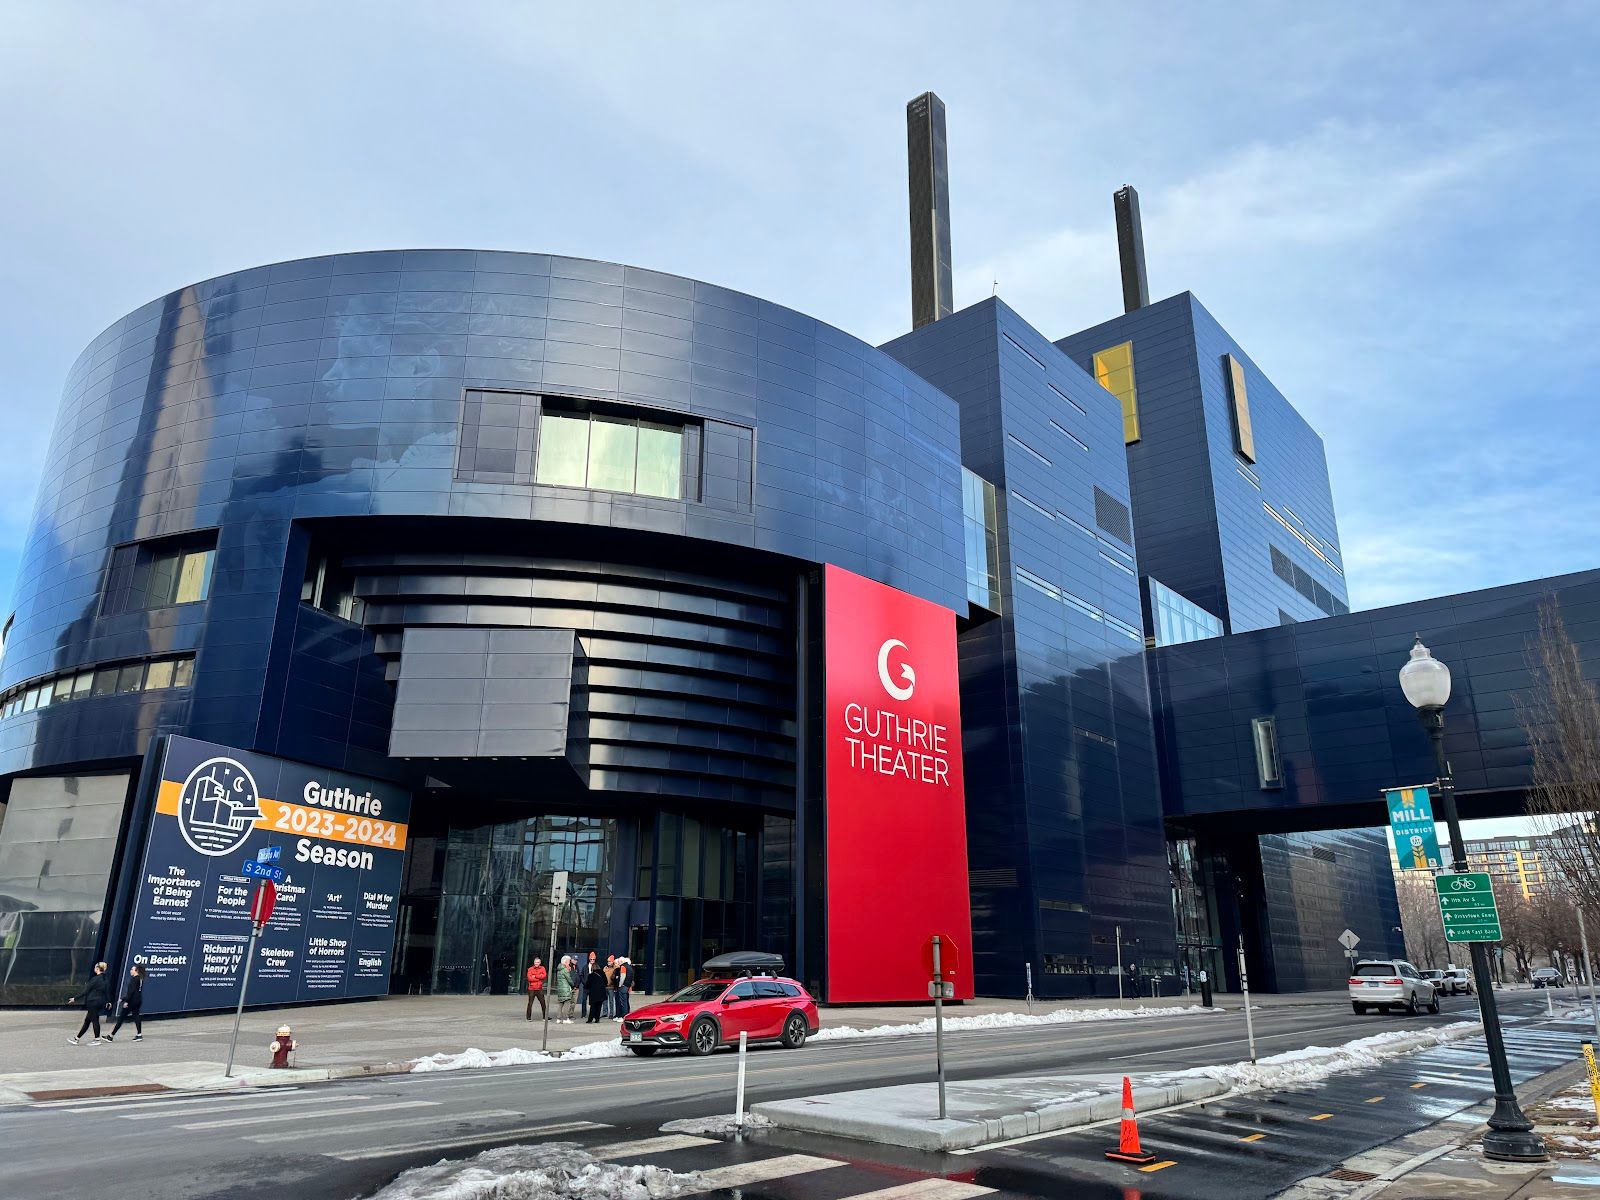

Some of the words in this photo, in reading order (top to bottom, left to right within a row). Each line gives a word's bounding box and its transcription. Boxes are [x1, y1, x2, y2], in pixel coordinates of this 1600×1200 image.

[845, 703, 948, 754] GUTHRIE
[845, 737, 949, 786] THEATER
[303, 781, 382, 816] Guthrie
[1392, 808, 1430, 822] MILL
[275, 805, 397, 846] 2023-2024
[1396, 827, 1432, 836] DISTRICT
[295, 838, 374, 871] Season
[169, 866, 186, 876] The
[245, 864, 252, 872] S
[254, 865, 272, 876] 2nd
[274, 870, 282, 880] St
[148, 874, 201, 887] Importance
[285, 875, 292, 883] A
[153, 886, 165, 894] of
[165, 886, 192, 898] Being
[218, 886, 233, 895] For
[235, 887, 248, 896] the
[275, 883, 306, 894] hristmas
[153, 896, 189, 907] Earnest
[217, 895, 246, 907] People
[276, 893, 296, 902] Carol
[364, 892, 376, 901] Dial
[384, 894, 393, 902] for
[366, 901, 388, 910] Murder
[309, 938, 328, 946] Little
[329, 939, 347, 948] Shop
[203, 944, 236, 954] Richard
[237, 946, 243, 954] II
[260, 948, 294, 957] Skeleton
[318, 948, 345, 956] Horrors
[134, 954, 148, 964] On
[150, 955, 187, 964] Beckett
[204, 954, 230, 965] Henry
[232, 955, 242, 964] IV
[266, 958, 286, 966] Crew
[358, 958, 382, 967] English
[203, 964, 229, 975] Henry
[231, 965, 238, 973] V
